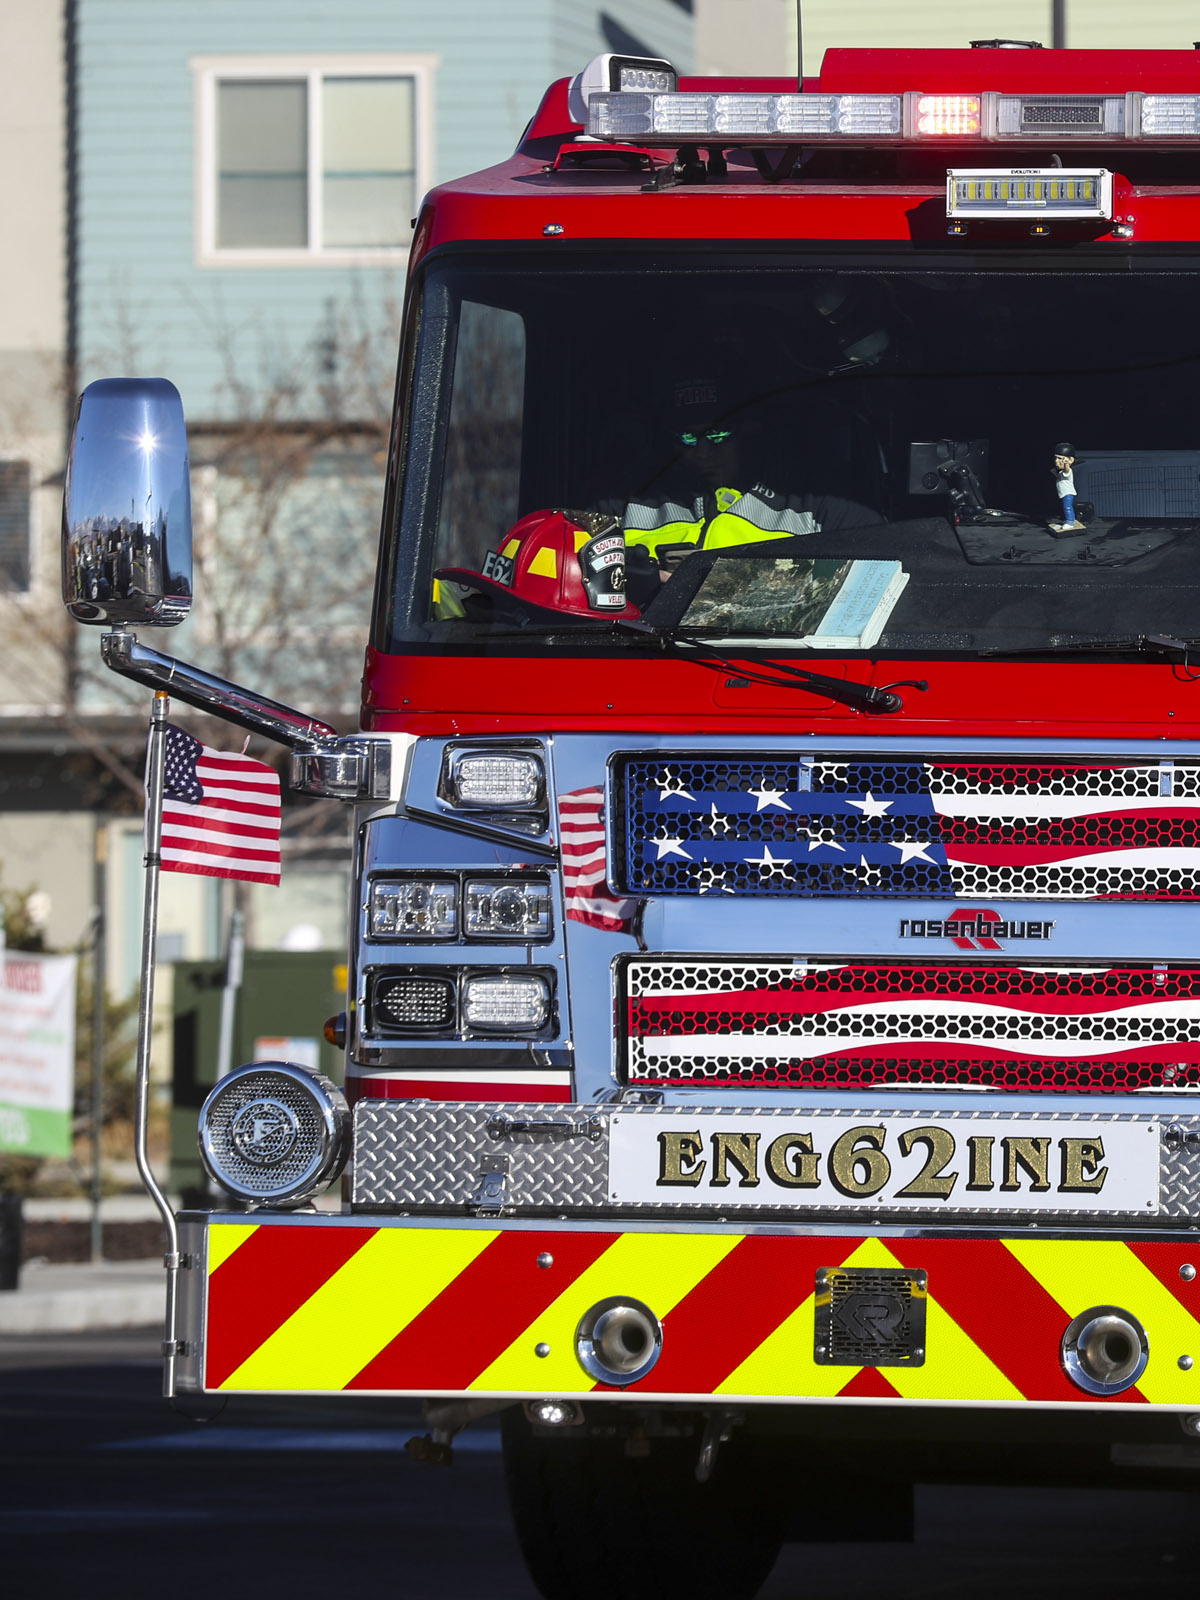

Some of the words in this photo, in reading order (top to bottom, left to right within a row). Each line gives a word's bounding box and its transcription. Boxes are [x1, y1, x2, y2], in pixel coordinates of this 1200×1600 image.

[596, 539, 616, 552] SOUTH
[481, 551, 513, 586] E62
[900, 912, 1056, 940] rosenbauer
